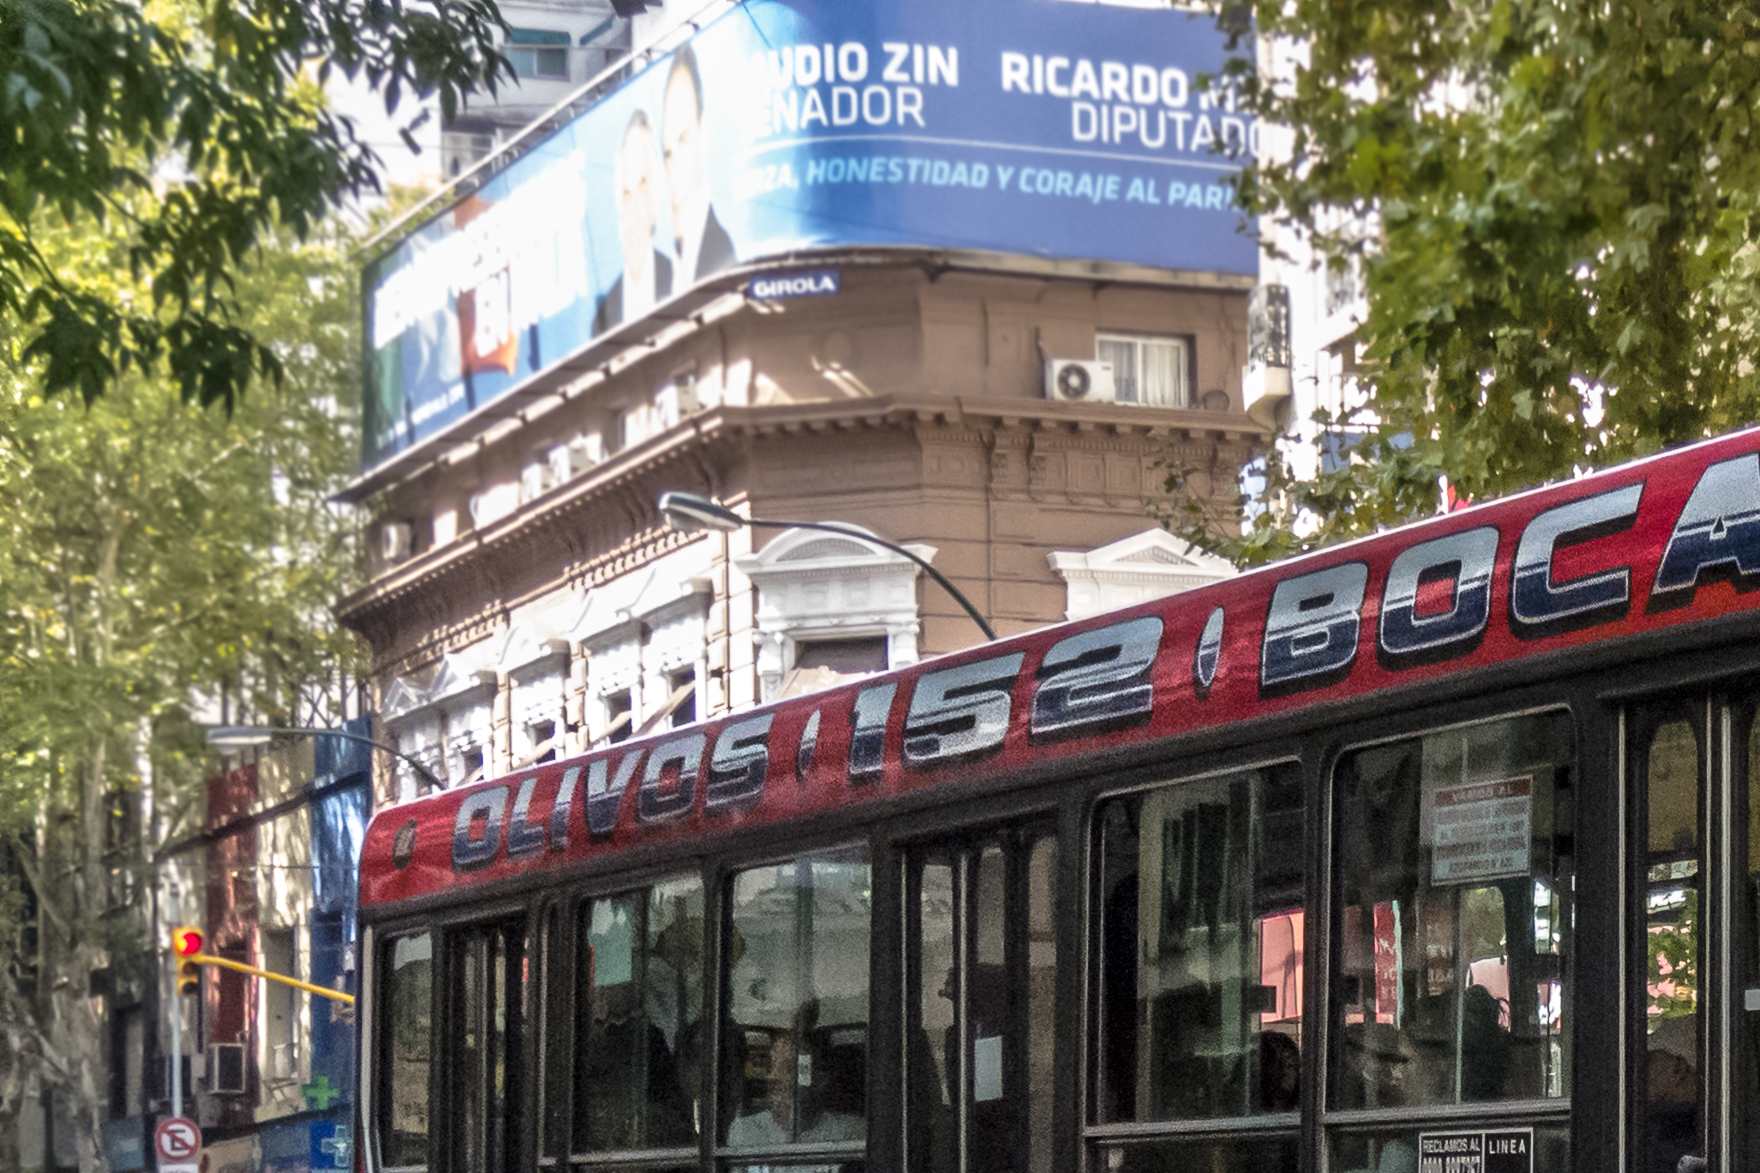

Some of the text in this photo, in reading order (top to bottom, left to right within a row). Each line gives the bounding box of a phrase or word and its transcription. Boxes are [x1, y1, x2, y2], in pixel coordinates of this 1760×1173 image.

[882, 42, 959, 87] ZIN
[1001, 51, 1188, 108] RICARDO
[806, 157, 990, 189] HONESTIDAD
[996, 165, 1014, 191] Y
[1019, 167, 1121, 205] CORAJE
[1126, 179, 1161, 205] AL
[753, 275, 836, 298] GIROLA
[452, 713, 775, 873] OLIVOS
[848, 614, 1165, 785] 152
[1423, 1137, 1480, 1154] RECLAMOS AL
[1488, 1139, 1527, 1155] LINEA
